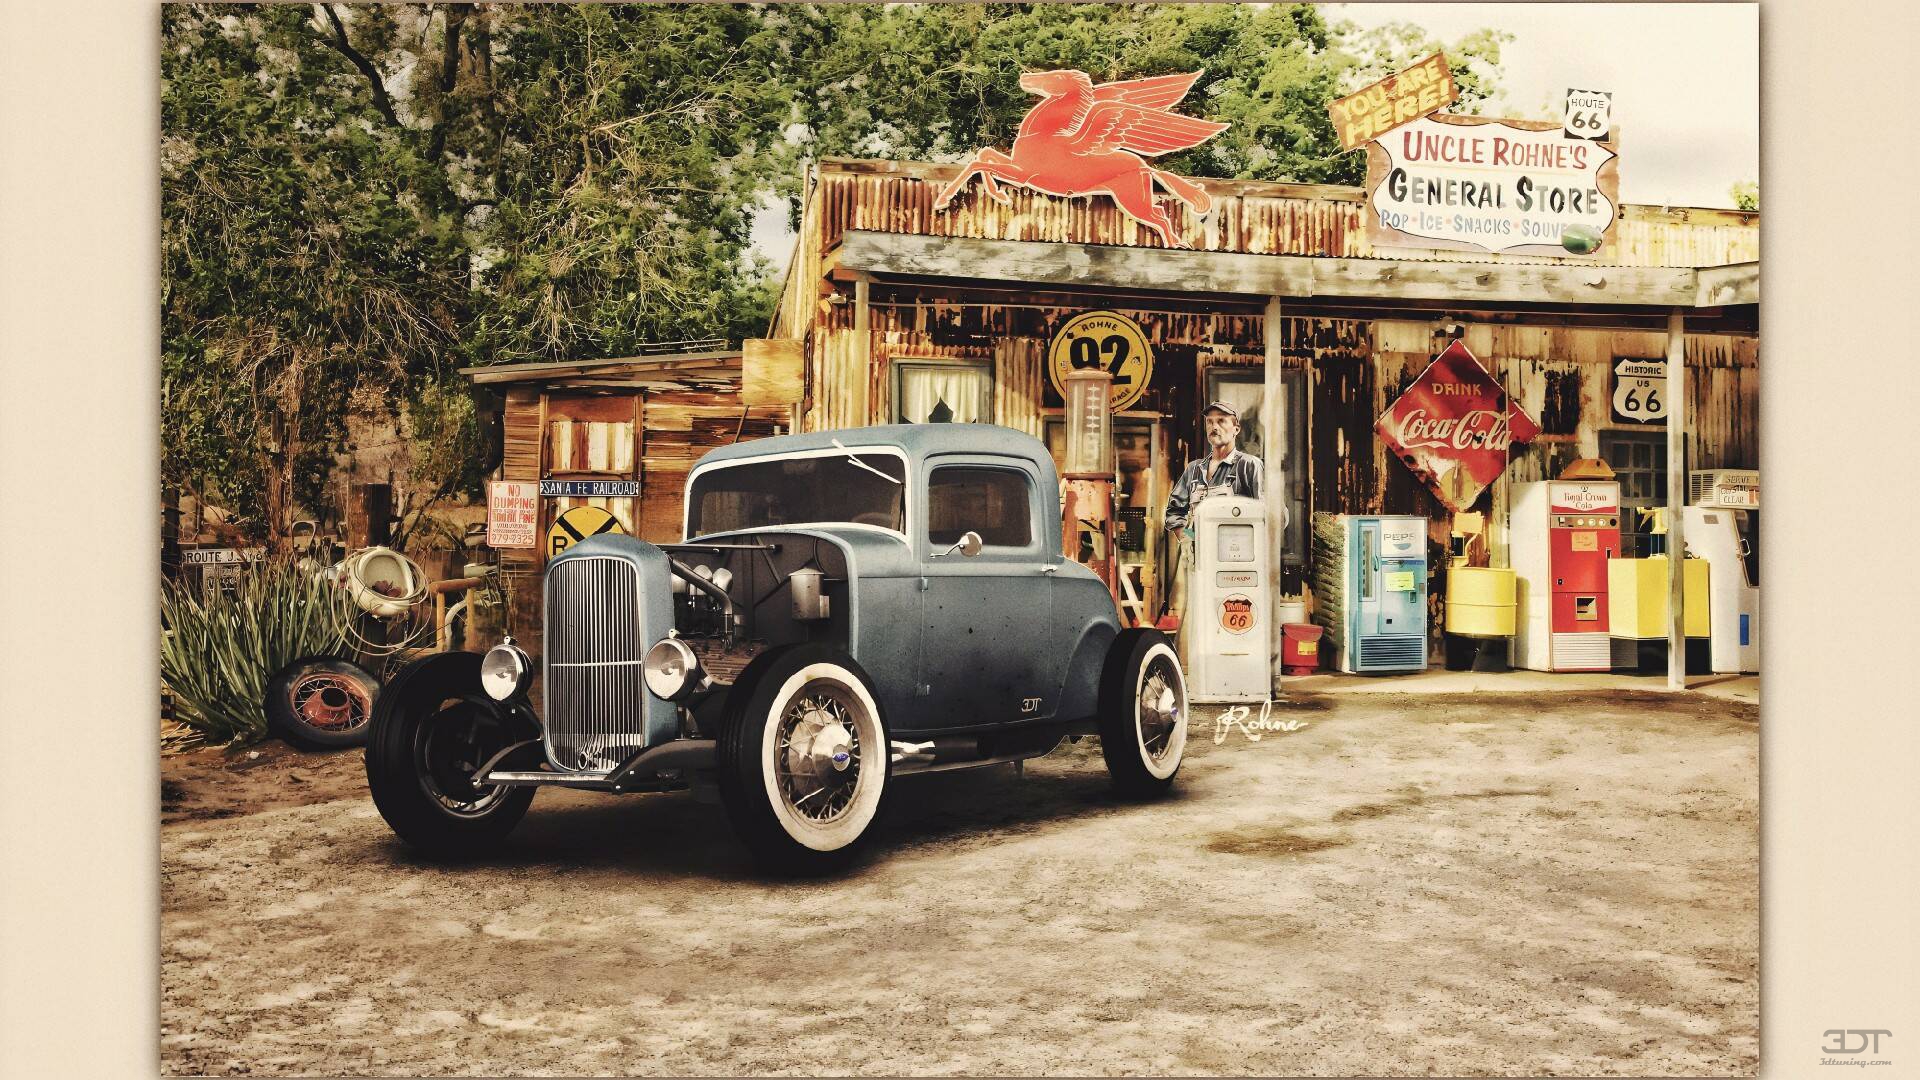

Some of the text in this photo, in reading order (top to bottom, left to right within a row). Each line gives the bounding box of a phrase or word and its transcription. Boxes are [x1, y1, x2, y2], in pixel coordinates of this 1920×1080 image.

[1335, 59, 1443, 121] YOU ARE
[1345, 79, 1450, 147] HERE!
[1571, 111, 1602, 130] 66
[1403, 130, 1588, 170] UNCLE ROHNE'S
[1388, 167, 1598, 215] GENERAL STORE
[1380, 208, 1409, 229] POP
[1420, 211, 1443, 231] ICE
[1453, 214, 1511, 236] SNACKS
[1081, 320, 1119, 332] ROHNE
[1625, 365, 1662, 375] HISTORIC
[1431, 382, 1482, 397] DRINK
[1636, 379, 1650, 387] US
[1624, 388, 1661, 413] 66
[1397, 409, 1514, 450] Coca-Cola
[508, 484, 521, 497] NO
[593, 482, 636, 495] RAILROAD
[494, 497, 535, 510] DUMPING
[1575, 501, 1593, 510] Cola
[1383, 533, 1417, 541] PEPS
[553, 536, 568, 556] R
[186, 552, 222, 562] ROUTE
[1229, 614, 1248, 628] 66
